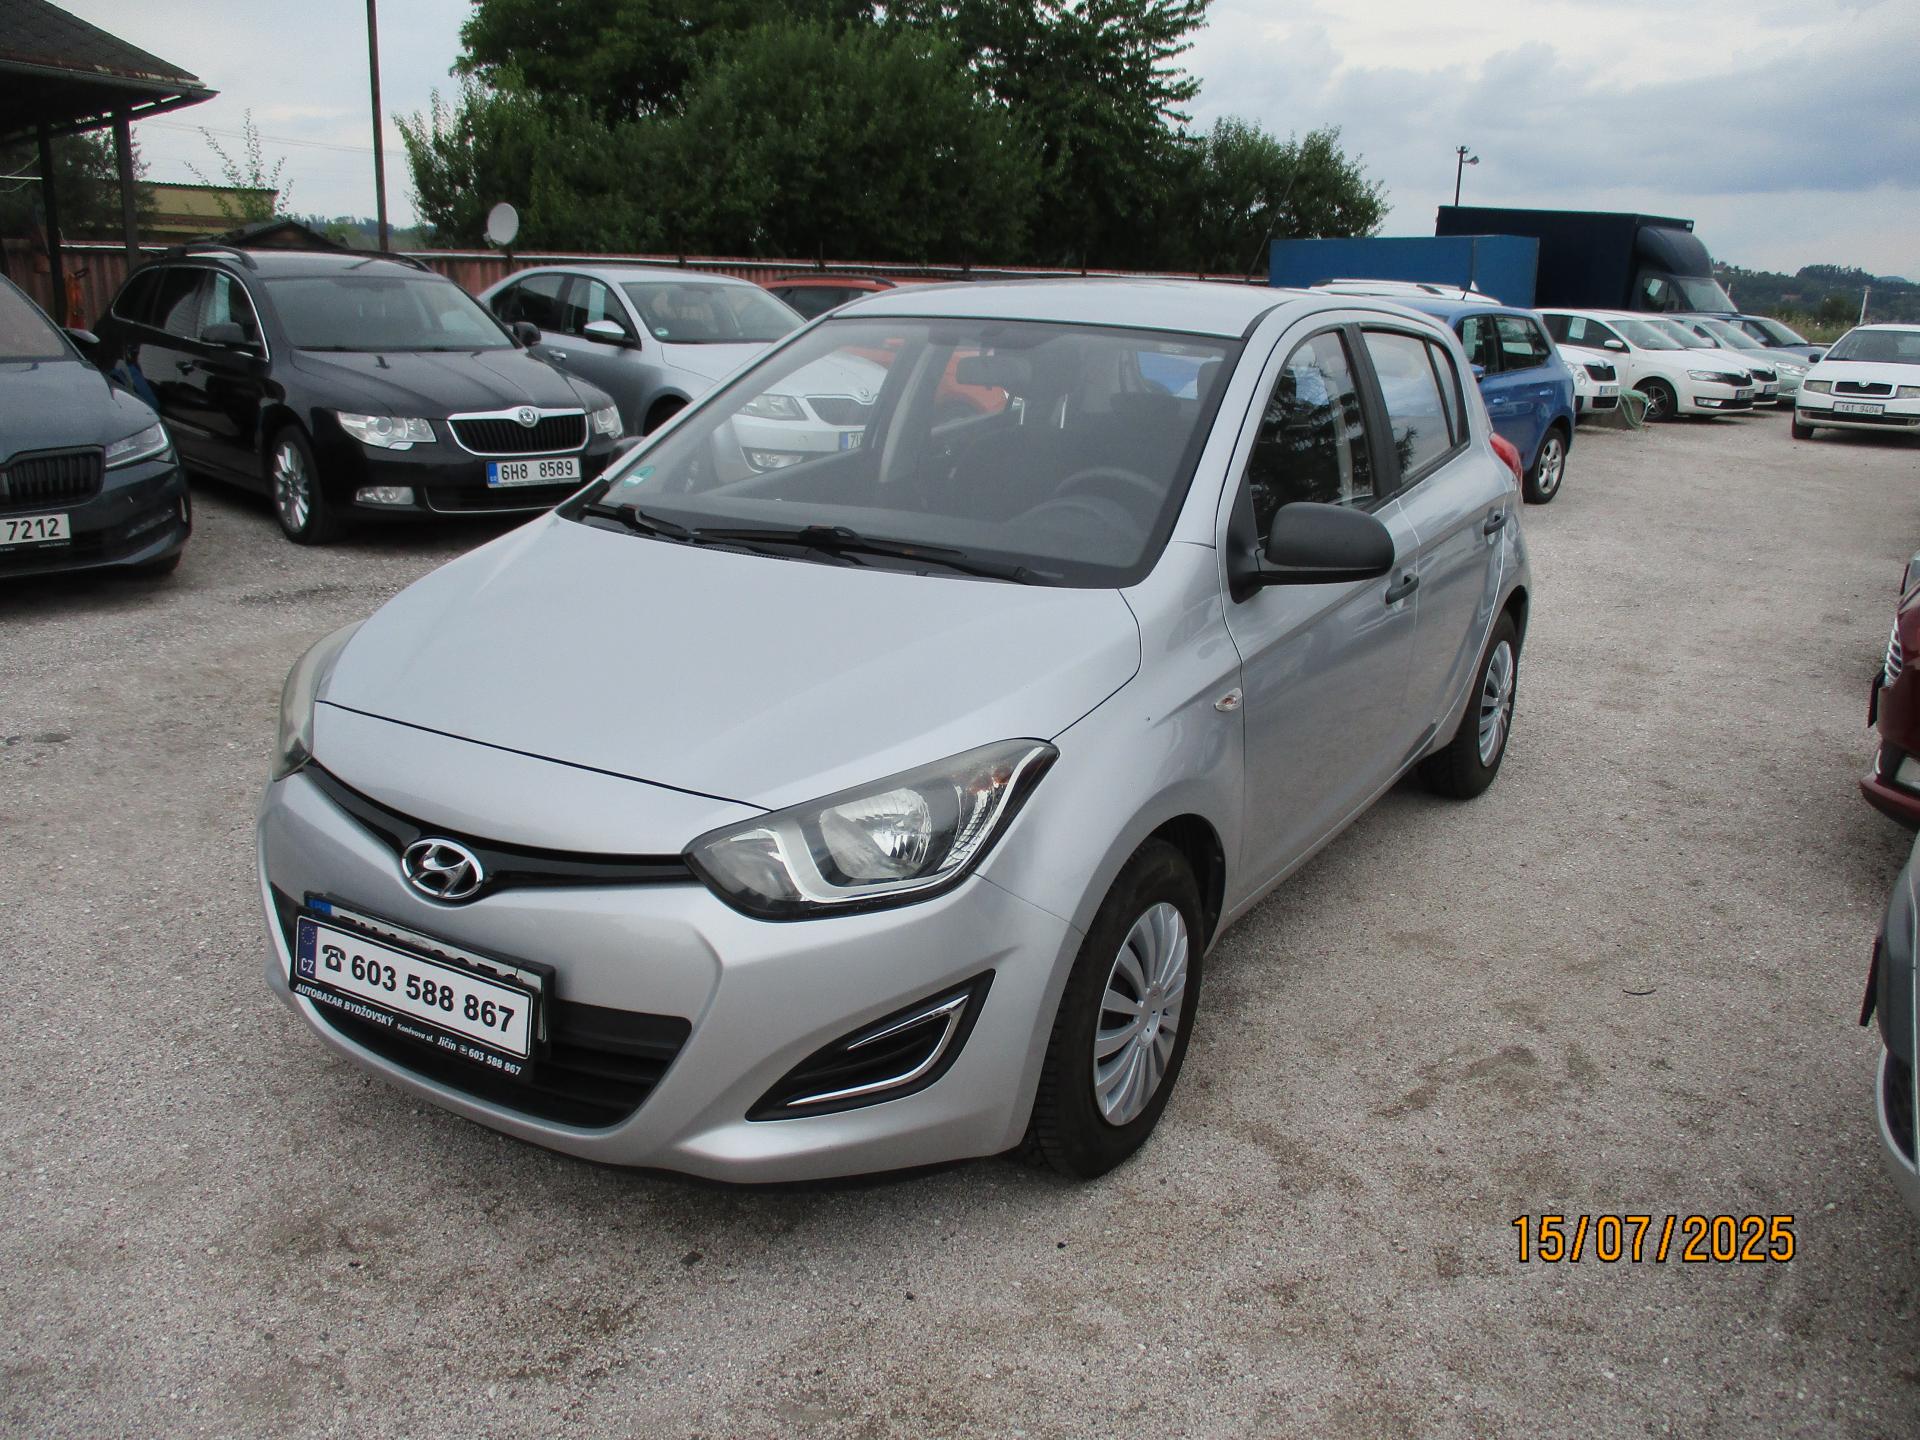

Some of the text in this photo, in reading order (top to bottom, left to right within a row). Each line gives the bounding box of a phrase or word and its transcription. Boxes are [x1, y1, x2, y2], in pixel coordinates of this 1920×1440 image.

[501, 461, 573, 480] 6H8 8589
[6, 517, 60, 541] 7212
[301, 957, 314, 974] CZ
[351, 954, 515, 1032] 603 588 867
[295, 983, 343, 1008] AUTOBAZAR
[343, 1000, 394, 1027] BYDŽOVSKÝ
[468, 1048, 485, 1062] 603
[486, 1055, 503, 1069] 588
[504, 1062, 522, 1076] 867
